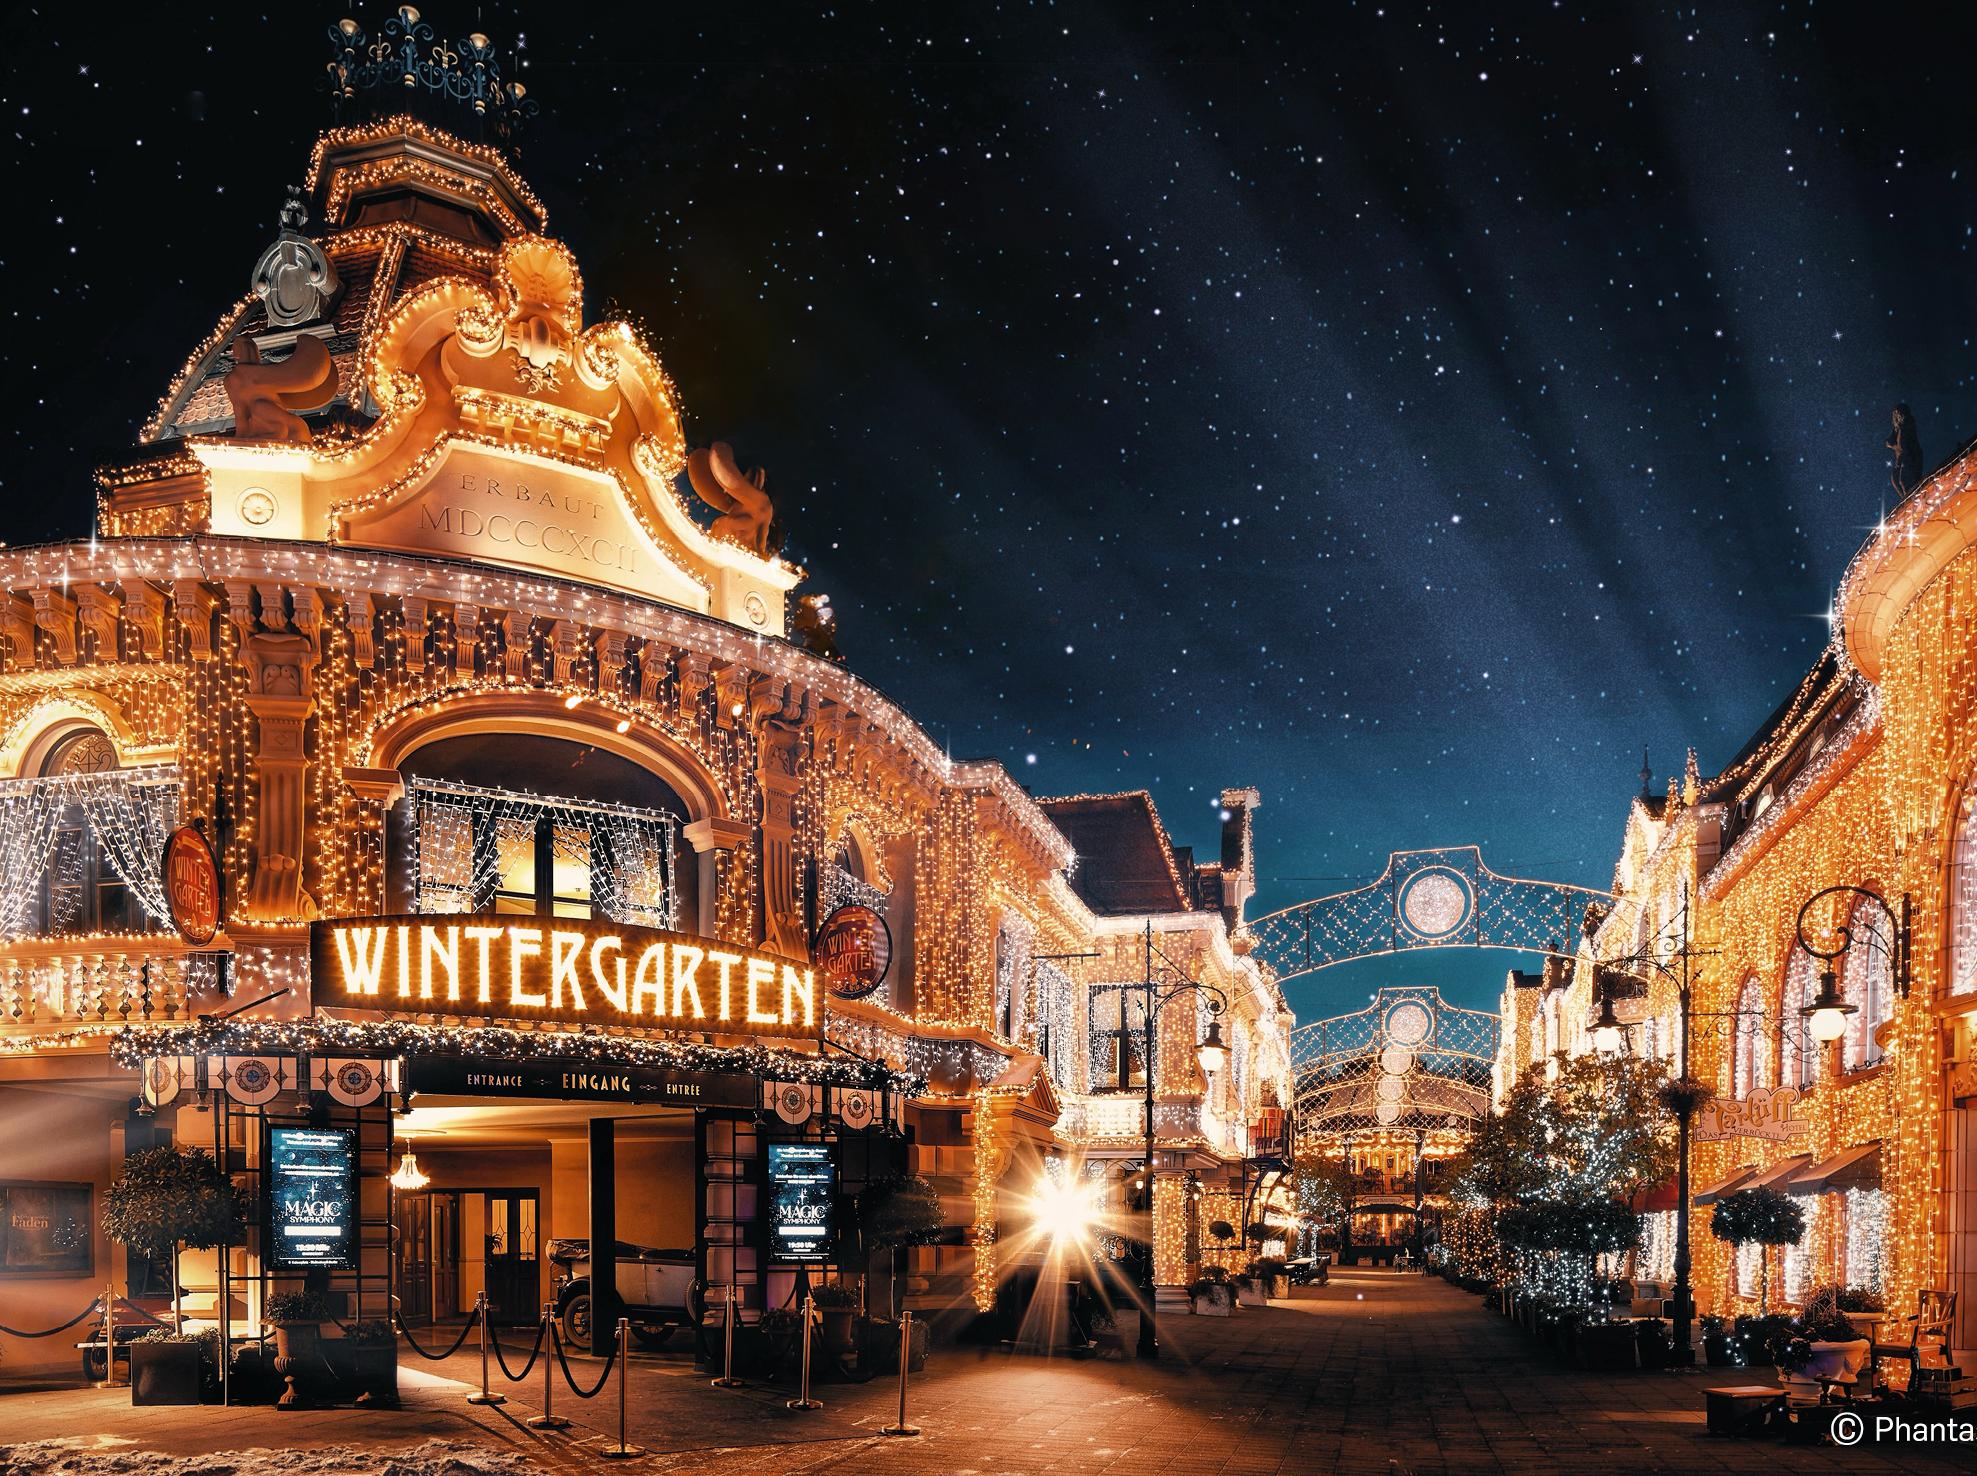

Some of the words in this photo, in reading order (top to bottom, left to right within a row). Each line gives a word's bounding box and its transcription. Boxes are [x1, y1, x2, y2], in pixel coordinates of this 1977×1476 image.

[461, 474, 604, 519] ERBAUT
[418, 503, 641, 573] MDCCCXCII
[174, 855, 211, 894] WINTER
[174, 881, 211, 917] GARTEN
[828, 930, 876, 954] WINTER
[827, 951, 877, 975] GARTEN
[333, 926, 816, 1027] WINTERGARTEN
[467, 1073, 523, 1087] ENTRANCE
[562, 1073, 631, 1092] EINGANG
[666, 1083, 700, 1096] ENTRÉE
[1698, 1129, 1720, 1139] DAS
[1781, 1122, 1807, 1132] HOTEL
[285, 1200, 342, 1217] MAGIC
[289, 1216, 336, 1224] SYMPHONY
[779, 1205, 826, 1219] MAGIC
